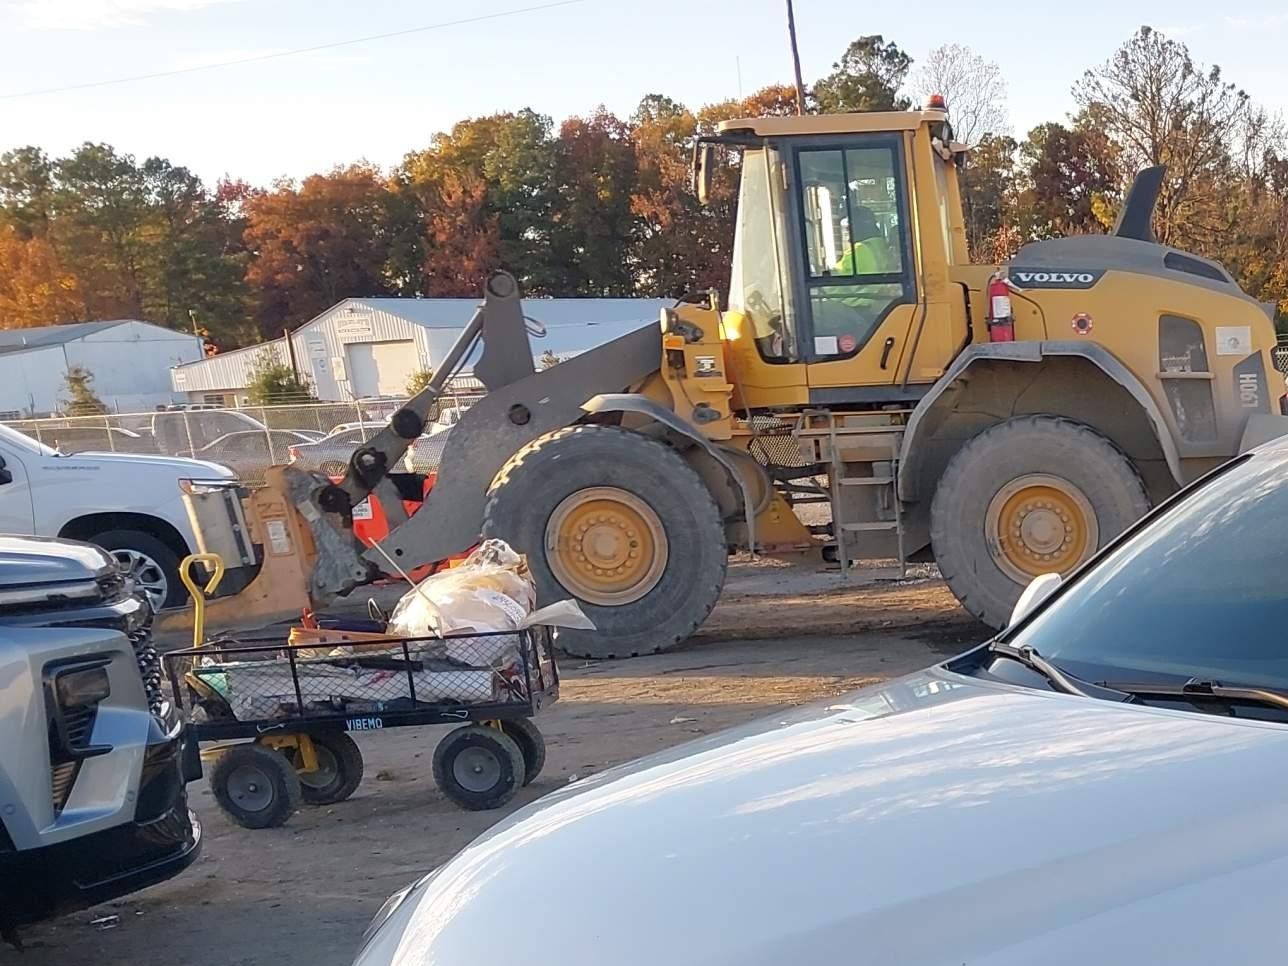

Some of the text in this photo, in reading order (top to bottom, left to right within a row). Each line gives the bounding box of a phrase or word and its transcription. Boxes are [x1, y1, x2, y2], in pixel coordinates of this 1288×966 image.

[1015, 272, 1094, 283] VOLVO
[1239, 373, 1259, 408] L90H
[345, 718, 383, 731] VIBEMO
